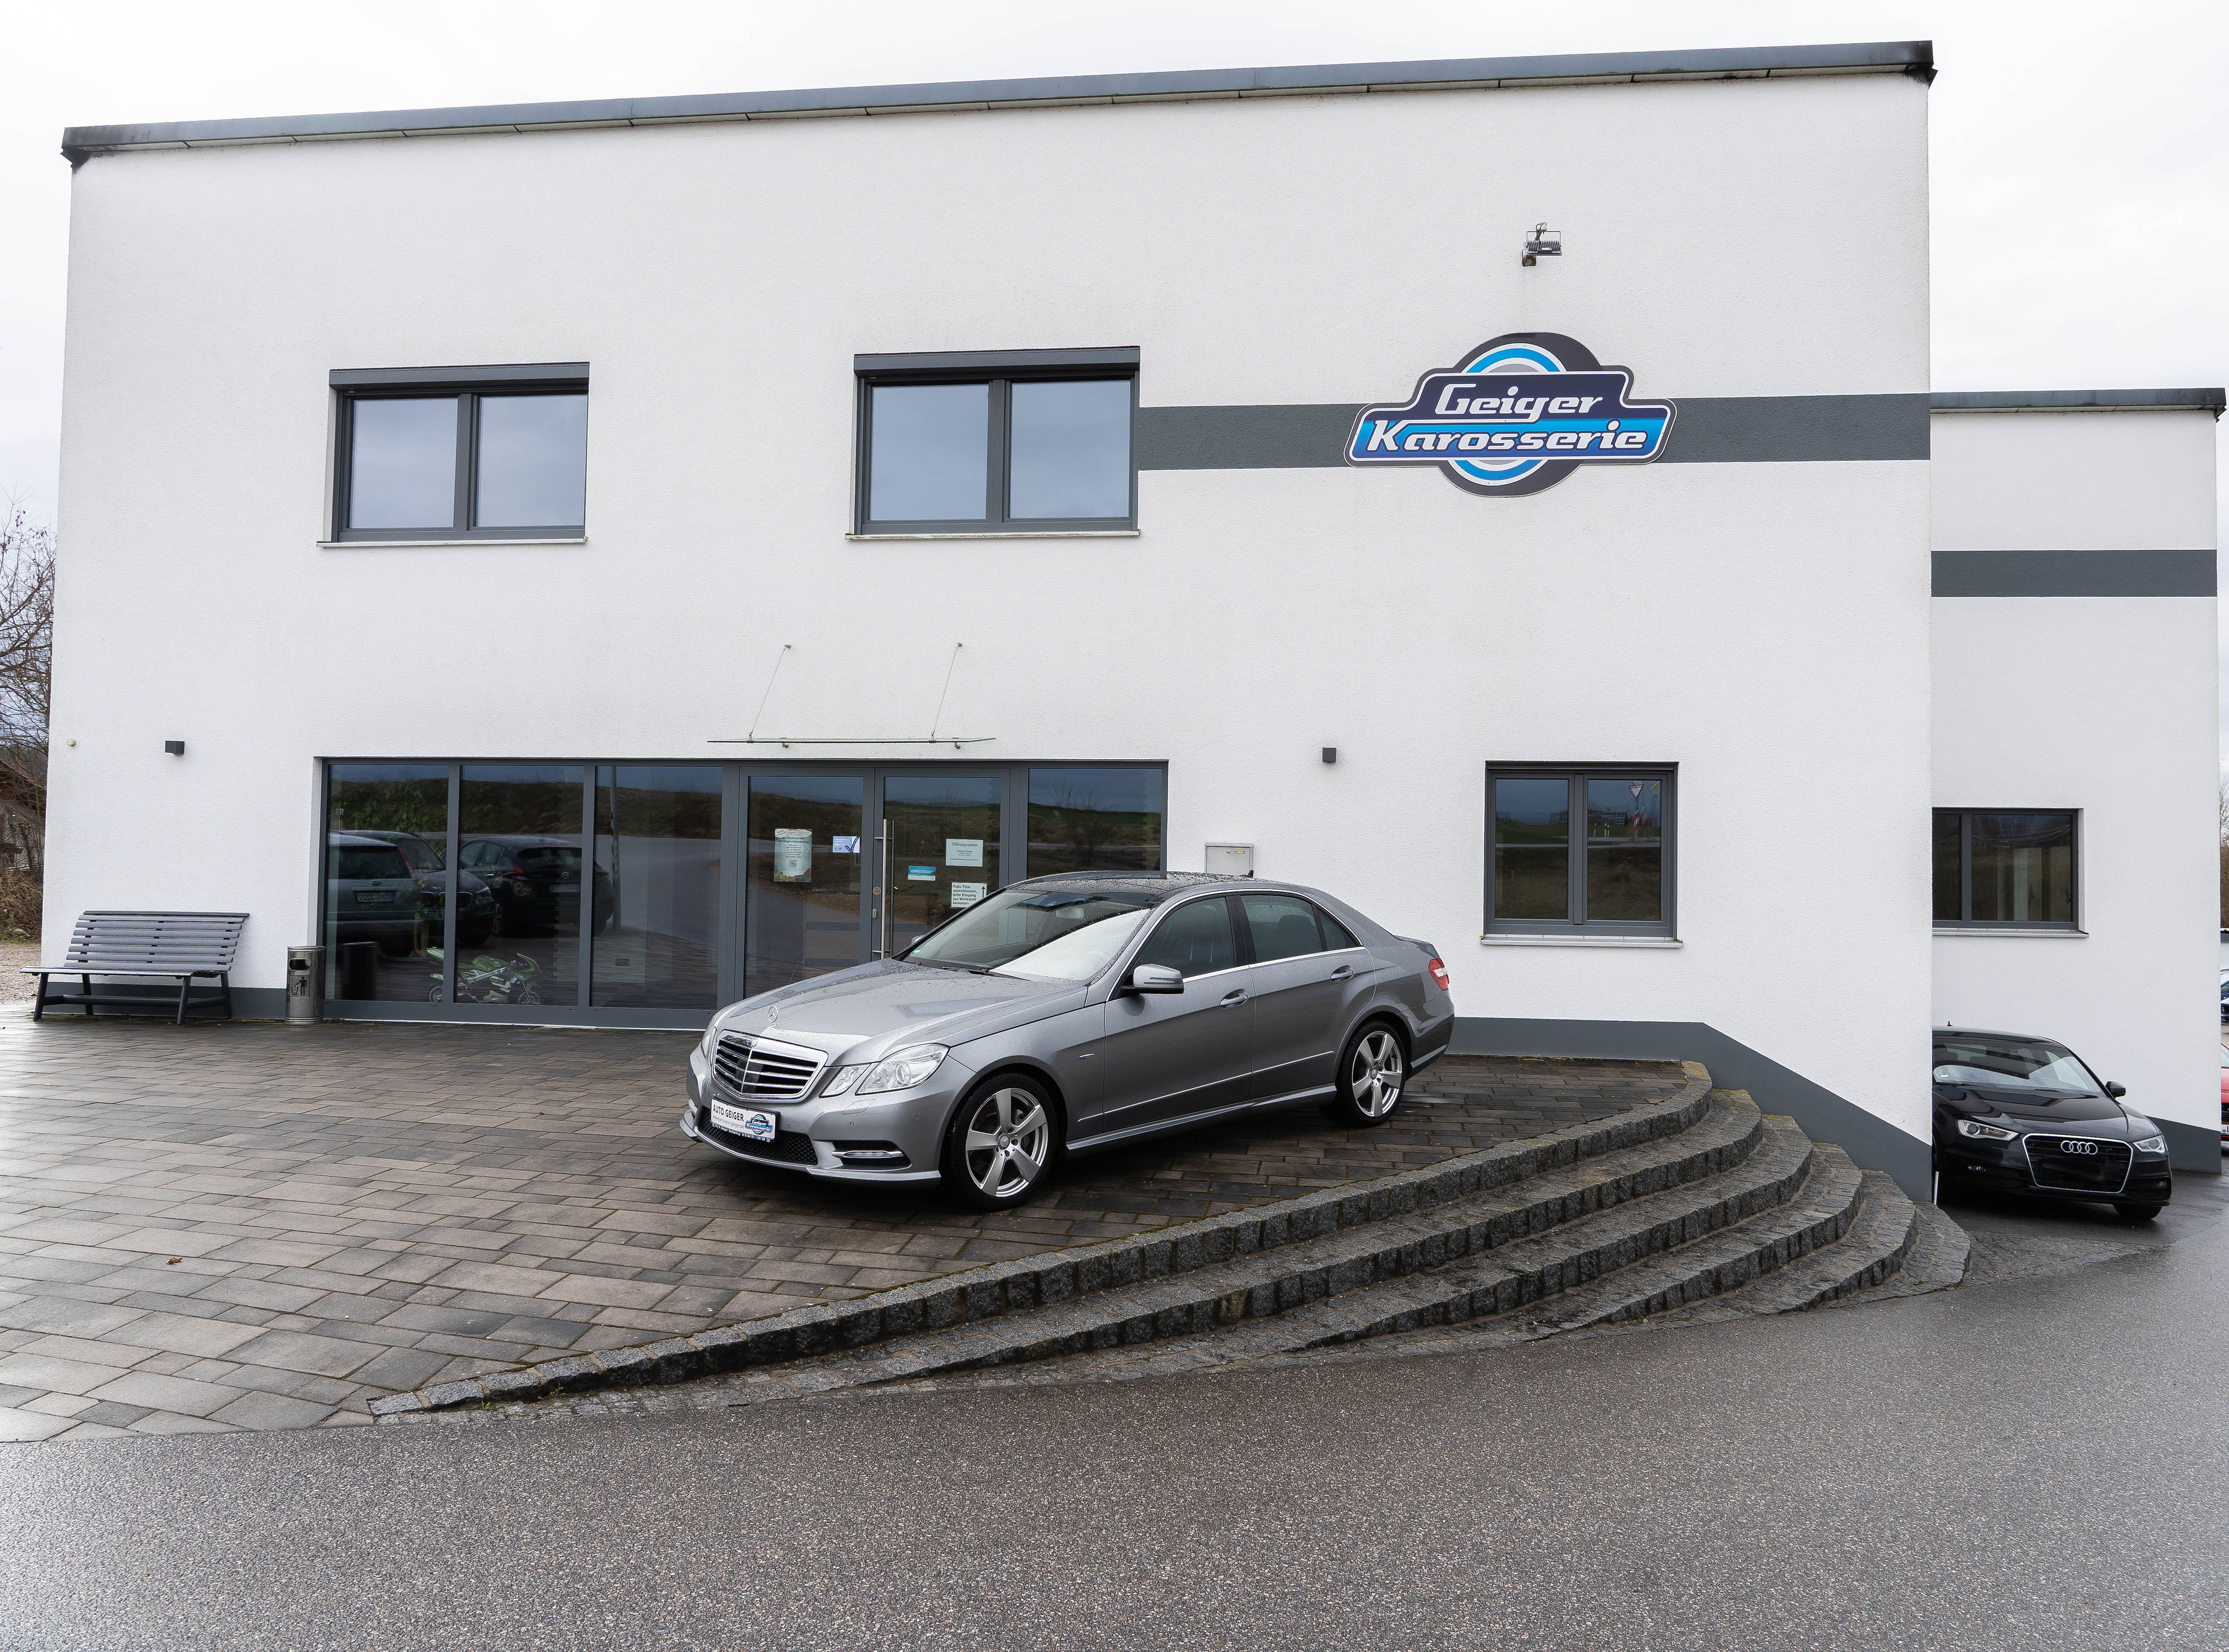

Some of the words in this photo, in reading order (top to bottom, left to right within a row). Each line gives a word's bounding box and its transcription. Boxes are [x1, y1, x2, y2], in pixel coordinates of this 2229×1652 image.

[1434, 383, 1603, 423] Geiger
[1367, 419, 1647, 451] Karosserie
[713, 1104, 724, 1116] AUTO
[725, 1109, 744, 1122] GEIGER
[746, 1122, 771, 1131] Karosserie
